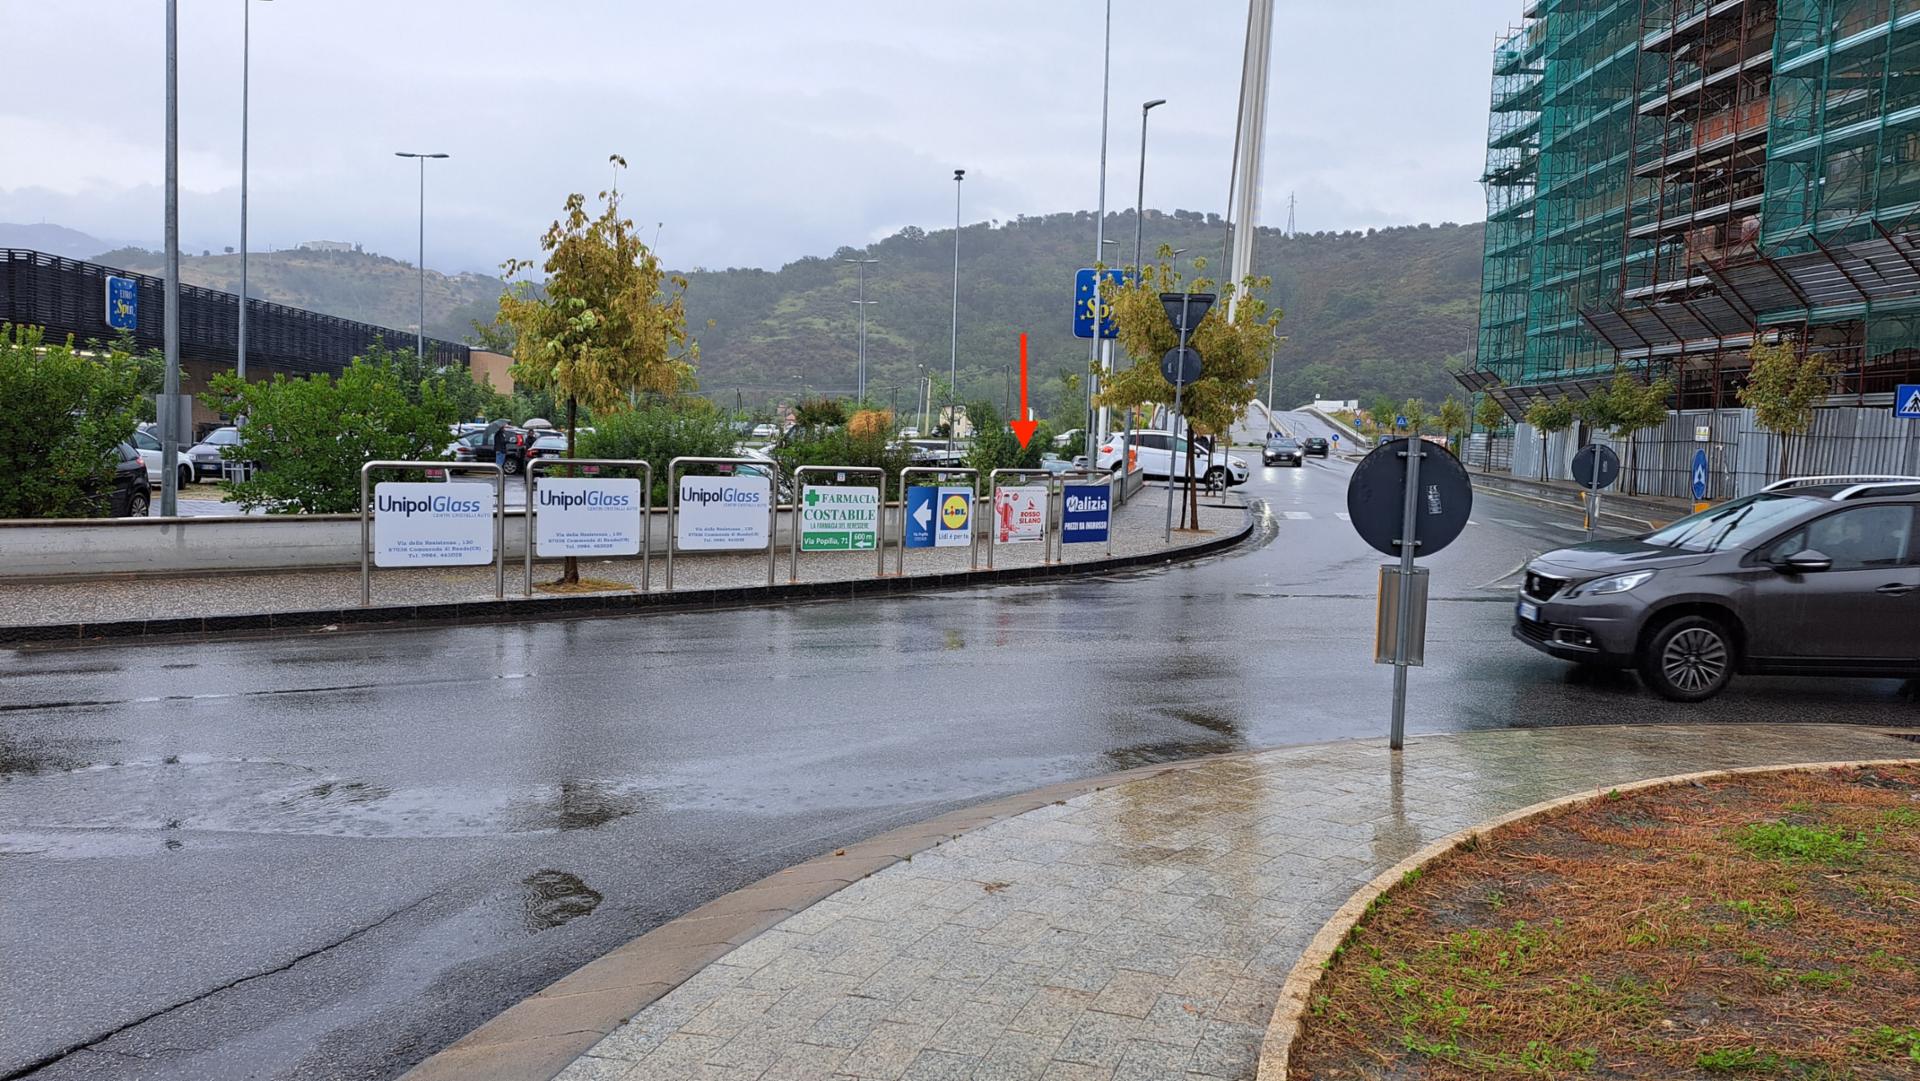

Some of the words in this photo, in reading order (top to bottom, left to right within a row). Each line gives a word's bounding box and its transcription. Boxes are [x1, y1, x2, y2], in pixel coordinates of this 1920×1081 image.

[378, 495, 480, 518] UnipolGlass
[540, 490, 629, 511] UnipolGlass
[682, 487, 760, 507] UnipolGlass
[822, 494, 876, 504] FARMACIA
[804, 509, 876, 520] COSTABILE
